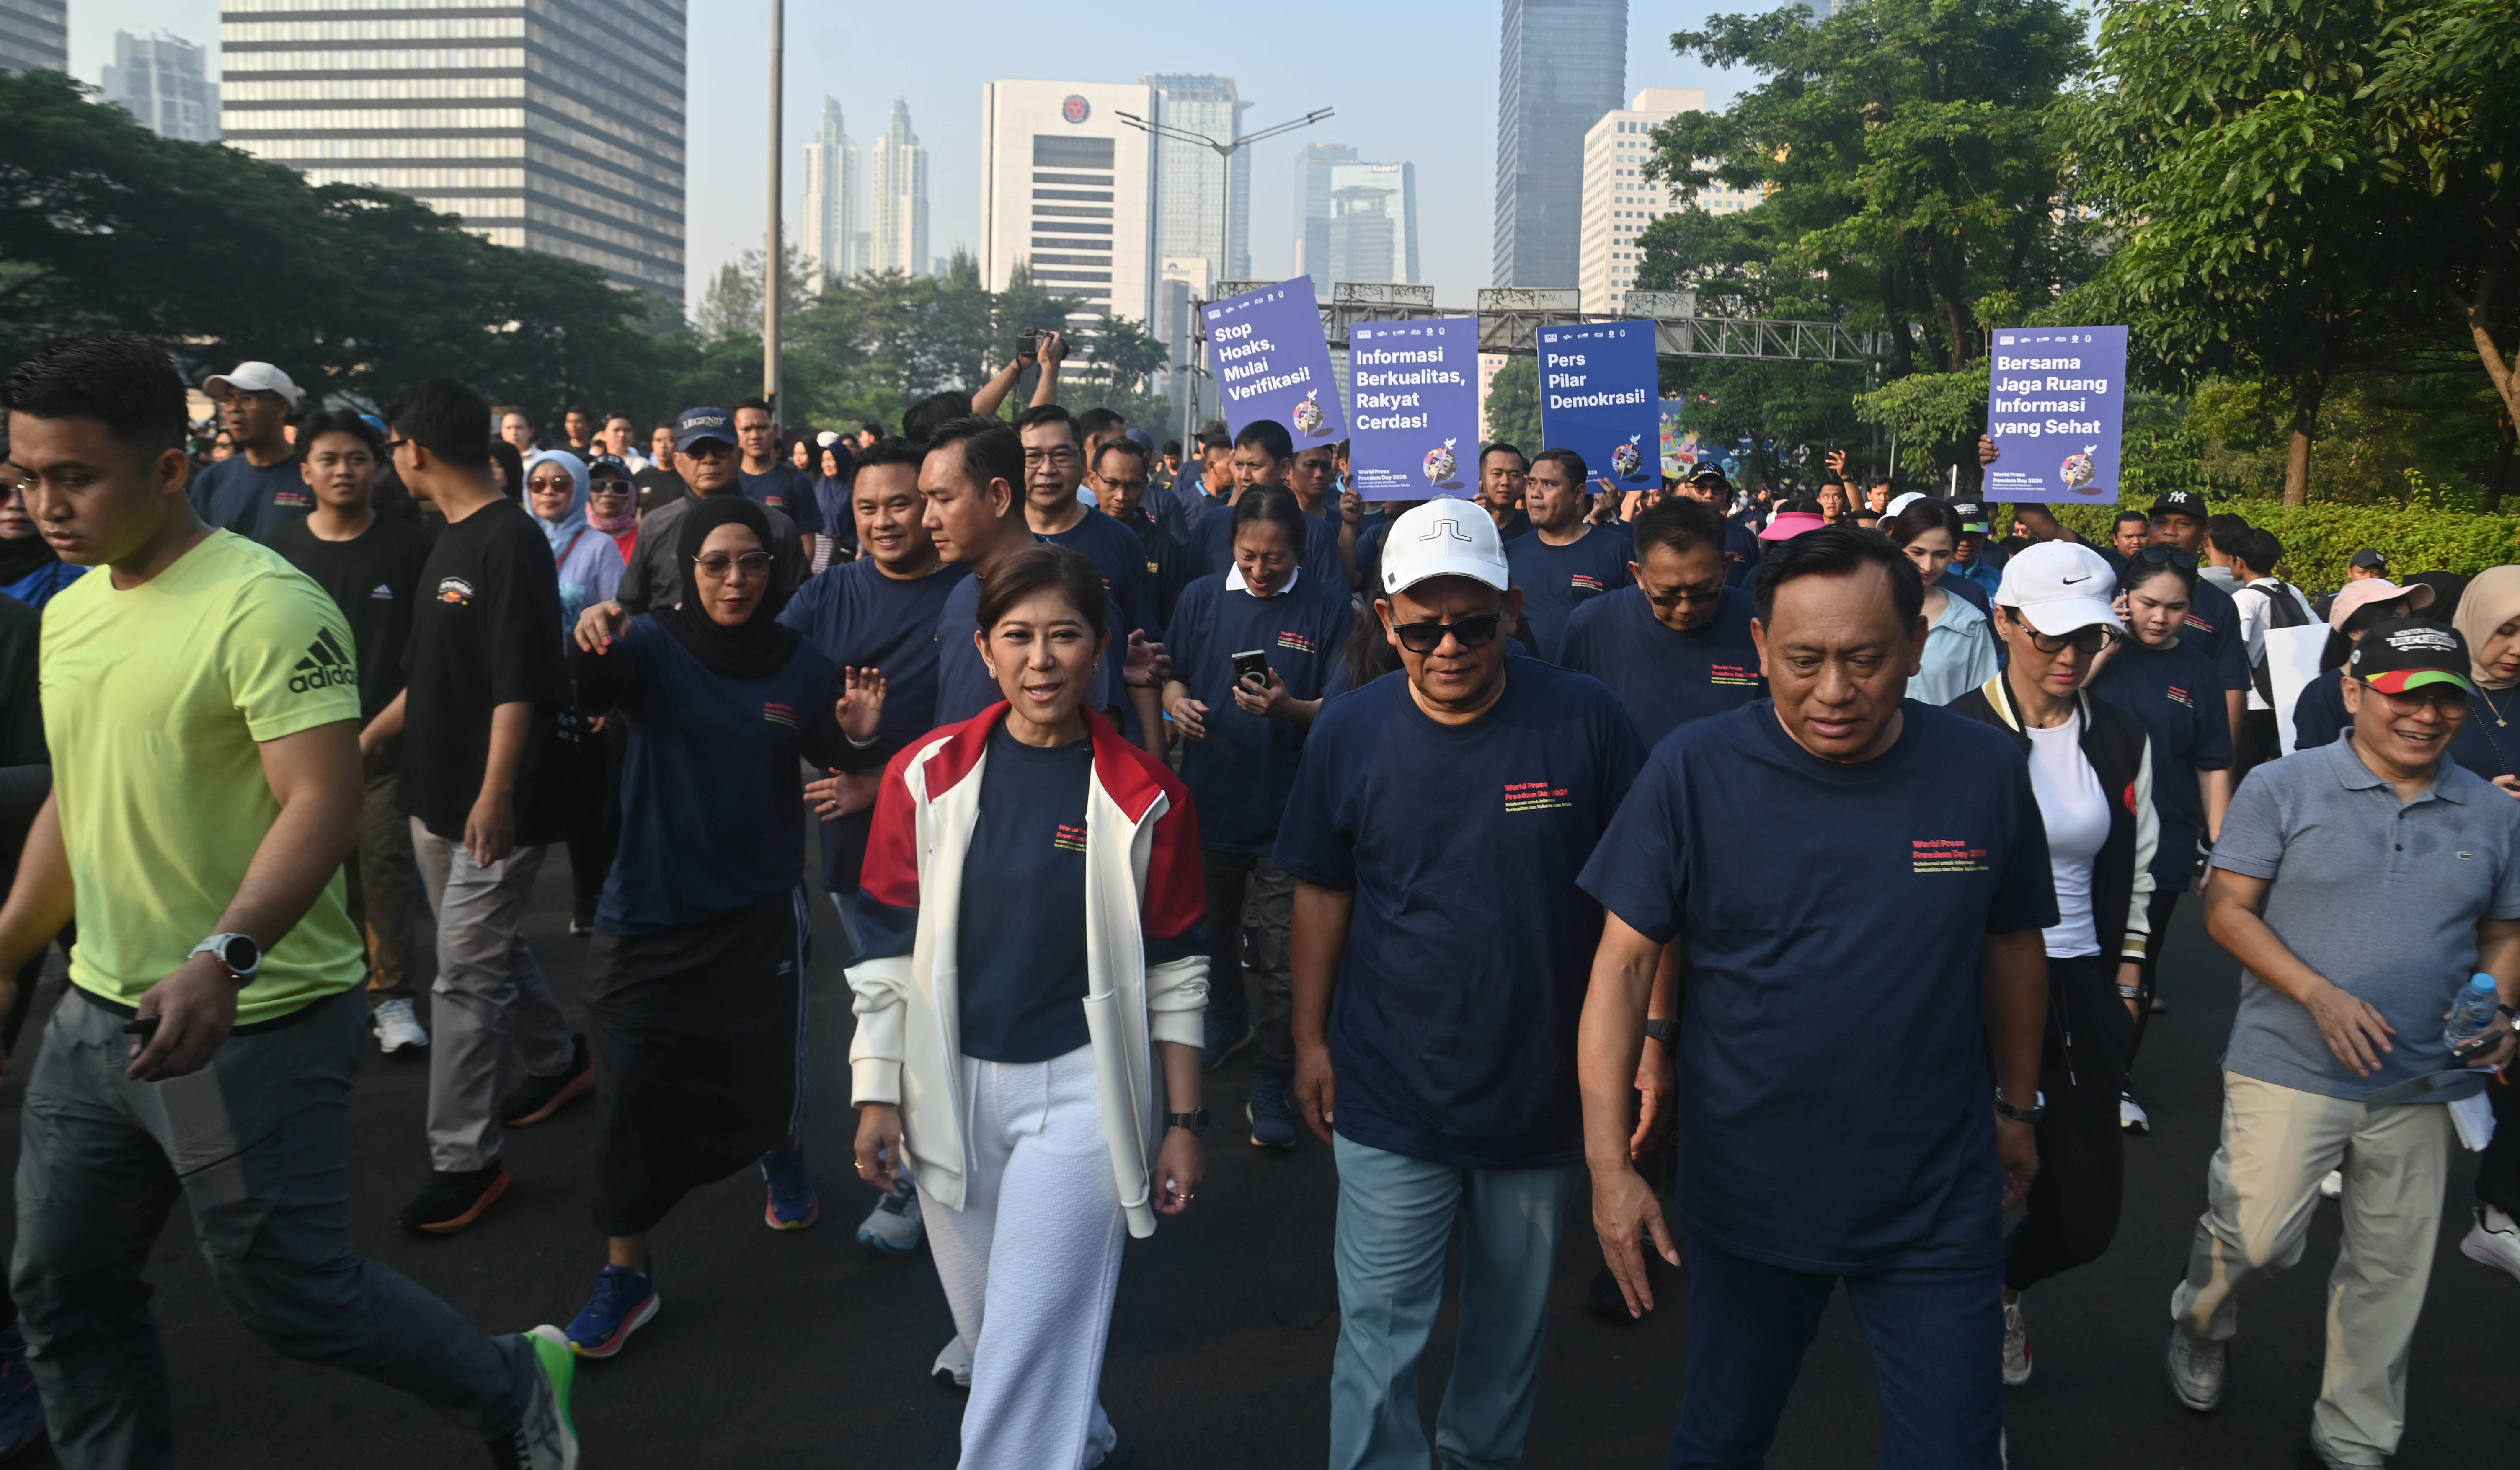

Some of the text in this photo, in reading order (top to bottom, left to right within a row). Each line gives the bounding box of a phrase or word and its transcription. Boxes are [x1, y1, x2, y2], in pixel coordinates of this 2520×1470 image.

[1215, 322, 1252, 342] Stop
[1219, 337, 1275, 362] Hoaks,
[1357, 346, 1443, 365] Informasi
[1224, 357, 1268, 382] Mulai
[1548, 353, 1586, 368] Pers
[1998, 356, 2081, 370] Bersama
[1228, 367, 1311, 401] Verifikasi!
[1357, 369, 1466, 386] Berkualitas,
[1549, 373, 1587, 388] Pilar
[1996, 377, 2107, 395] Jaga Ruang
[1357, 392, 1420, 411] Rakyat
[1550, 389, 1645, 409] Demokrasi!
[1996, 397, 2086, 413] Informasi
[1357, 413, 1428, 430] Cerdas!
[1994, 419, 2101, 437] yang Sehat
[1505, 783, 1526, 791] World
[1505, 791, 1537, 800] Freedom
